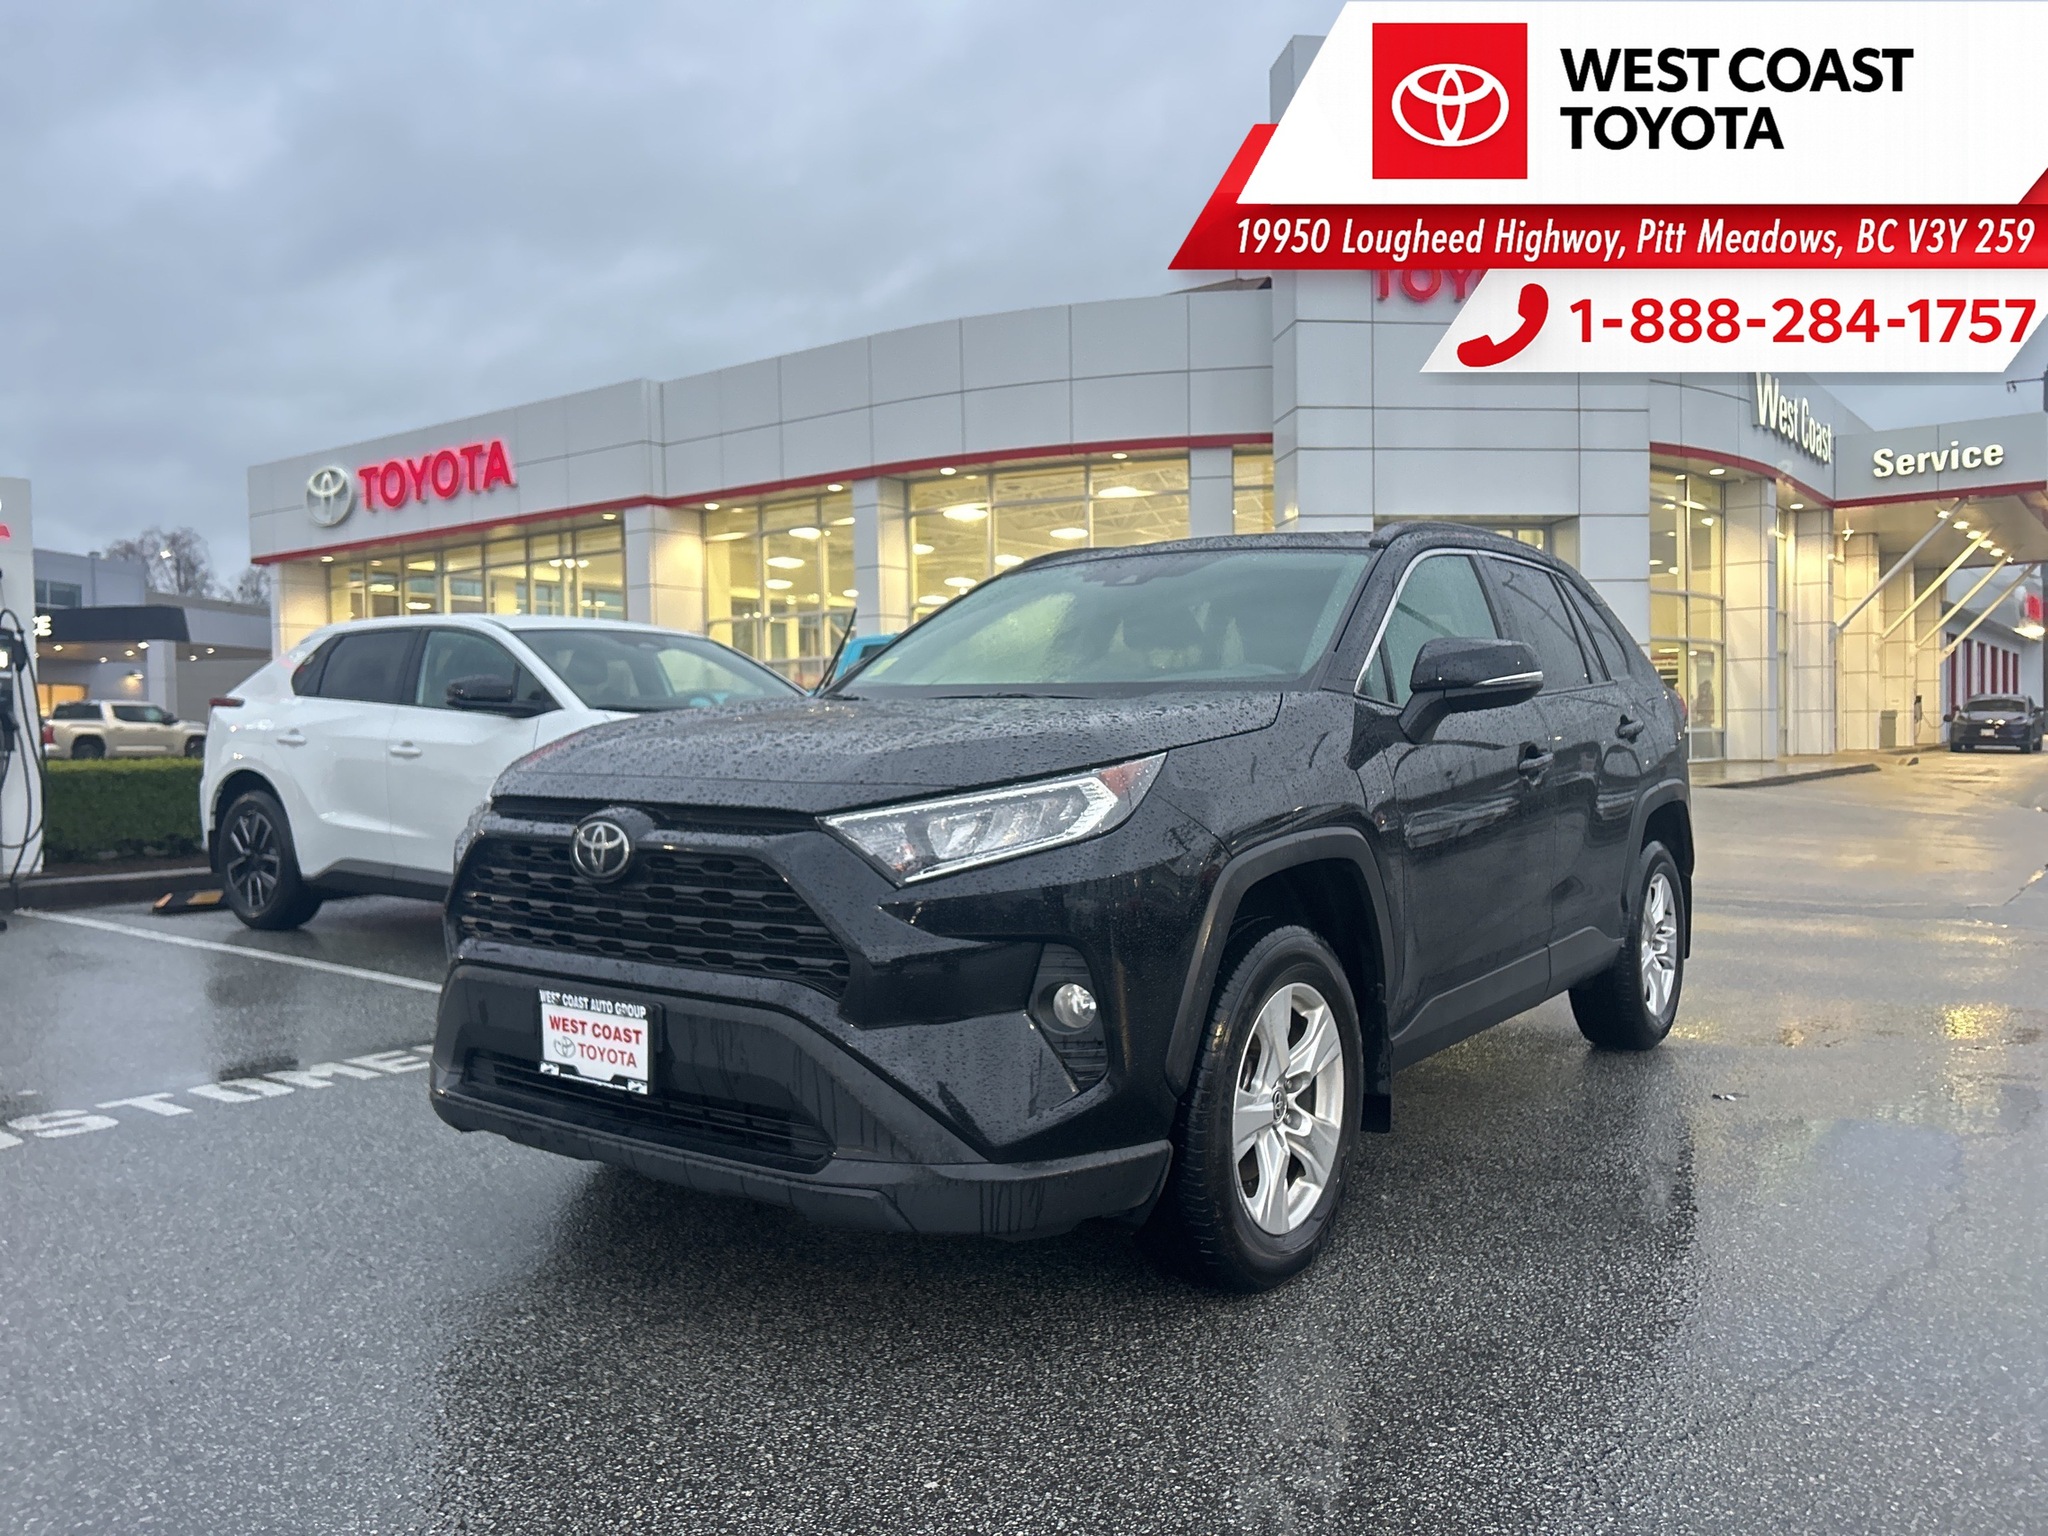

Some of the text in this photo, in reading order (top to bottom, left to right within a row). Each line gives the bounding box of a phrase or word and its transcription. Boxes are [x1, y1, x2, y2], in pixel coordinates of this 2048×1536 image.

[1755, 372, 1832, 464] West Coast
[358, 440, 513, 509] TOYOTA
[1872, 440, 2004, 478] Service
[561, 993, 589, 1010] COAST
[590, 998, 613, 1014] AUTO
[549, 1015, 643, 1045] WEST COAST
[578, 1042, 638, 1068] TOYOTA
